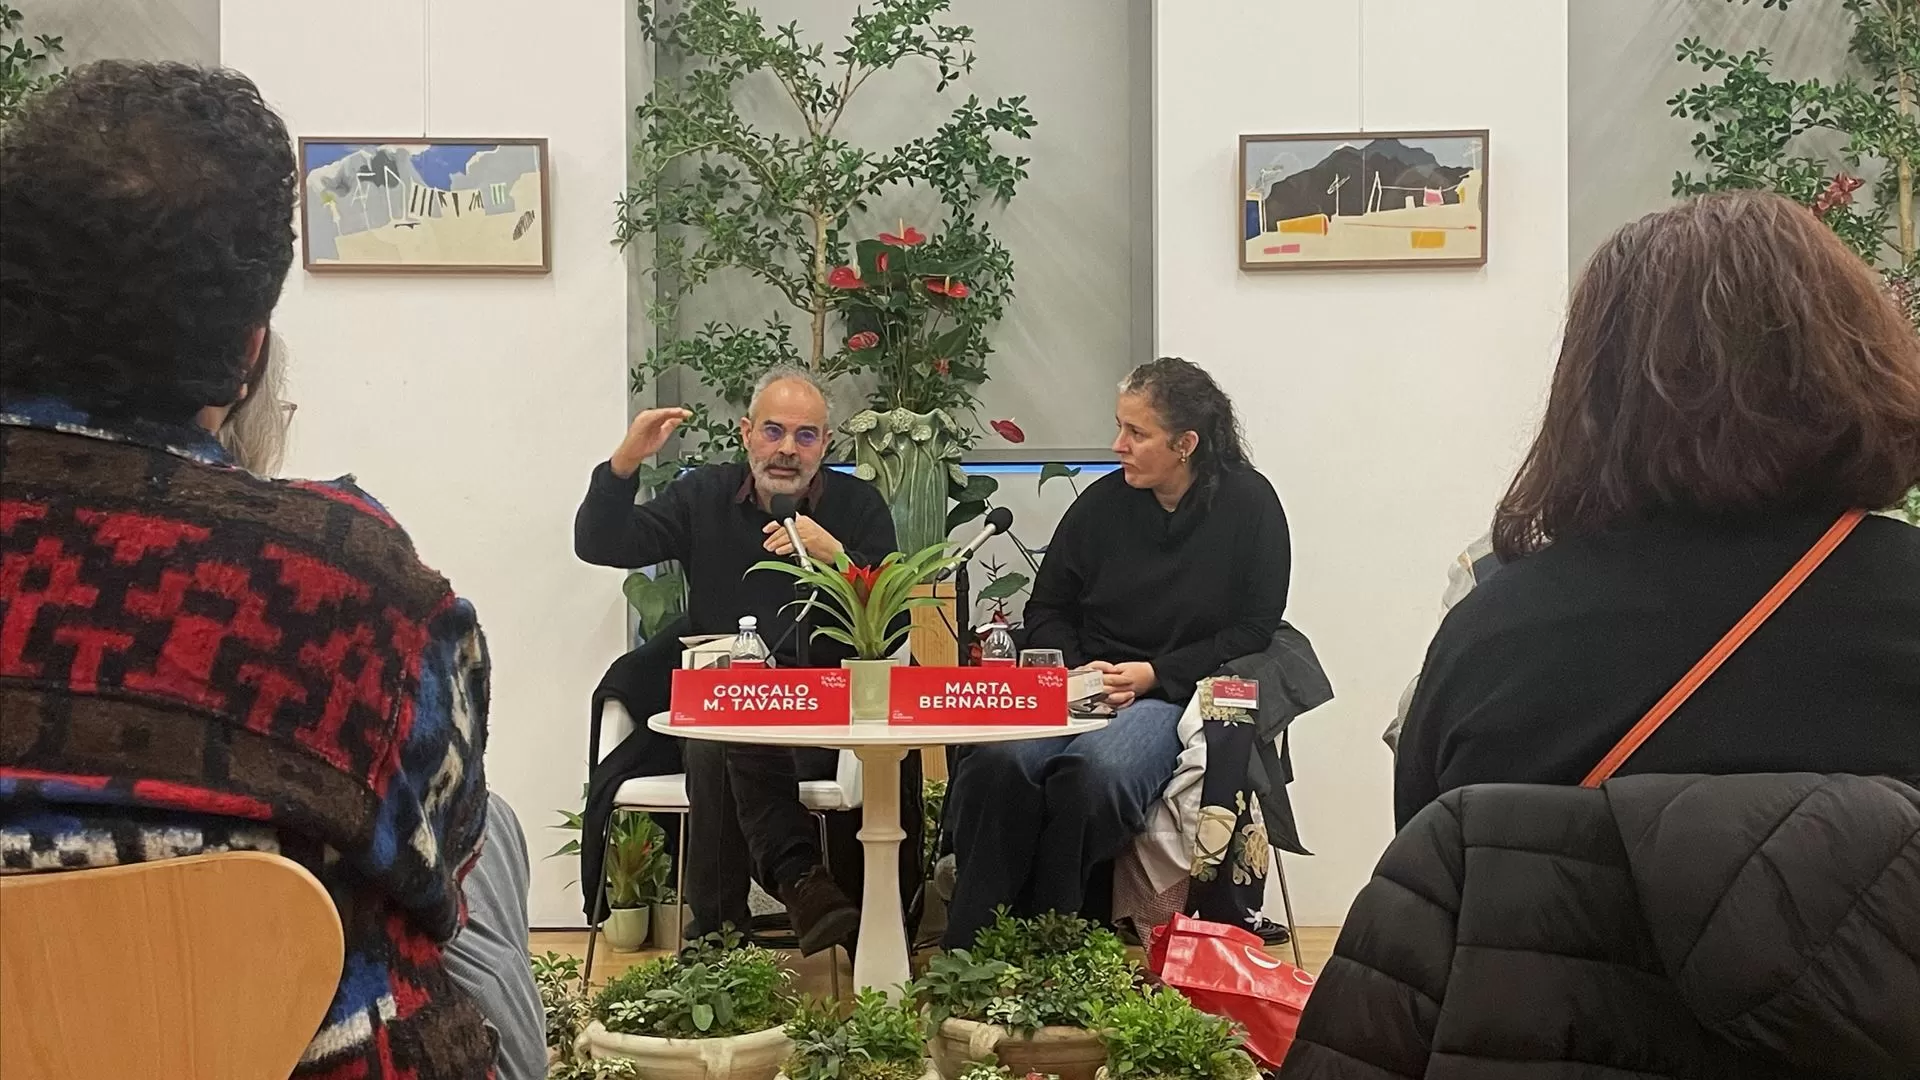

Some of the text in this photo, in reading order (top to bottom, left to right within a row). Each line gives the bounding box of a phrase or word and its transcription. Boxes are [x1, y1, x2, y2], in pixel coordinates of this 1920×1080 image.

[713, 684, 809, 699] GONÇALO
[945, 682, 1012, 695] MARTA
[703, 697, 819, 711] M. TAVARES
[919, 696, 1038, 709] BERNARDES
